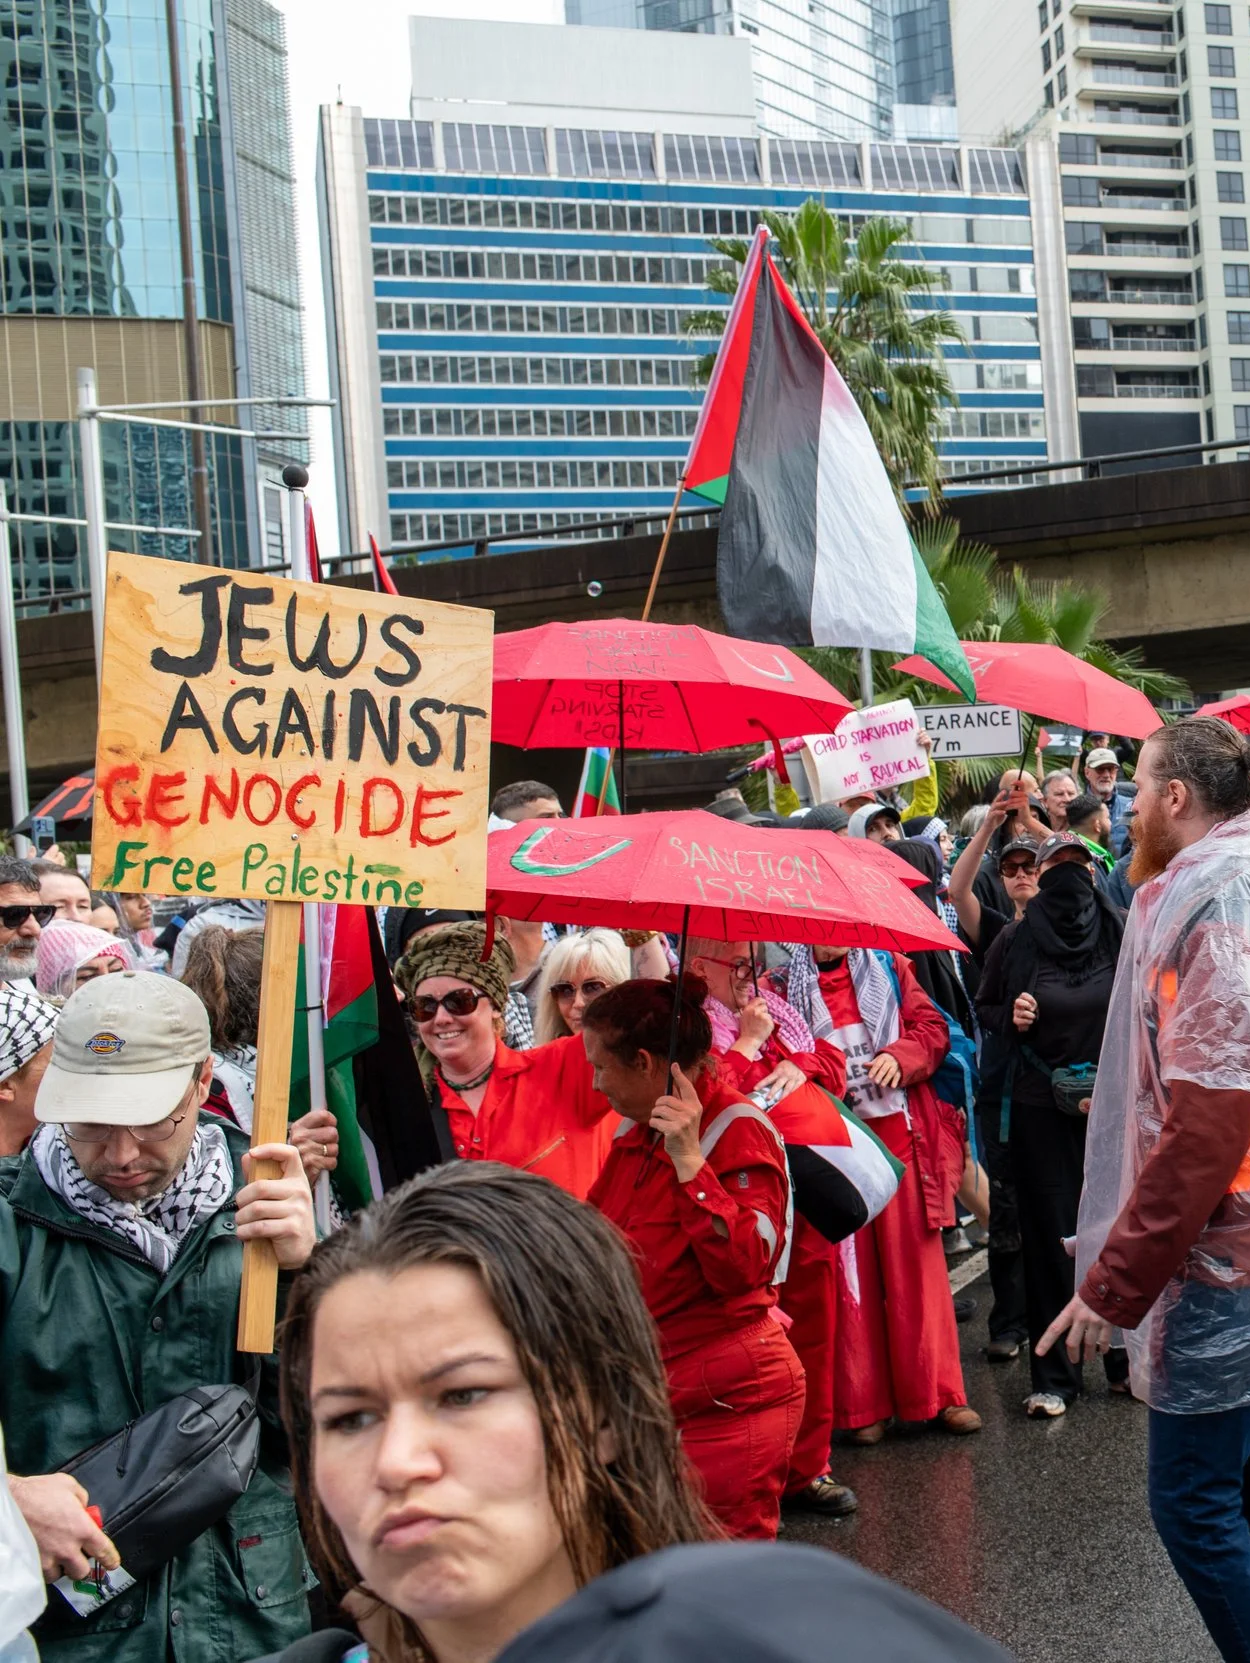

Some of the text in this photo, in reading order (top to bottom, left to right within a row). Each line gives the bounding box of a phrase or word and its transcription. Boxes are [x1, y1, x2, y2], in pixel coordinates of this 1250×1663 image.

[150, 574, 424, 687] JEWS
[160, 681, 487, 771] AGAINST
[813, 734, 848, 757] CHILD
[851, 717, 915, 747] STARVATION
[925, 710, 1012, 731] EARANCE
[859, 751, 872, 763] IS
[946, 740, 961, 752] m
[843, 772, 860, 788] NOT
[870, 757, 925, 782] RADICAL
[101, 762, 463, 848] GENOCIDE
[107, 841, 424, 907] Free Palestine
[668, 837, 822, 885] SANCTION
[694, 875, 846, 911] ISRAEL
